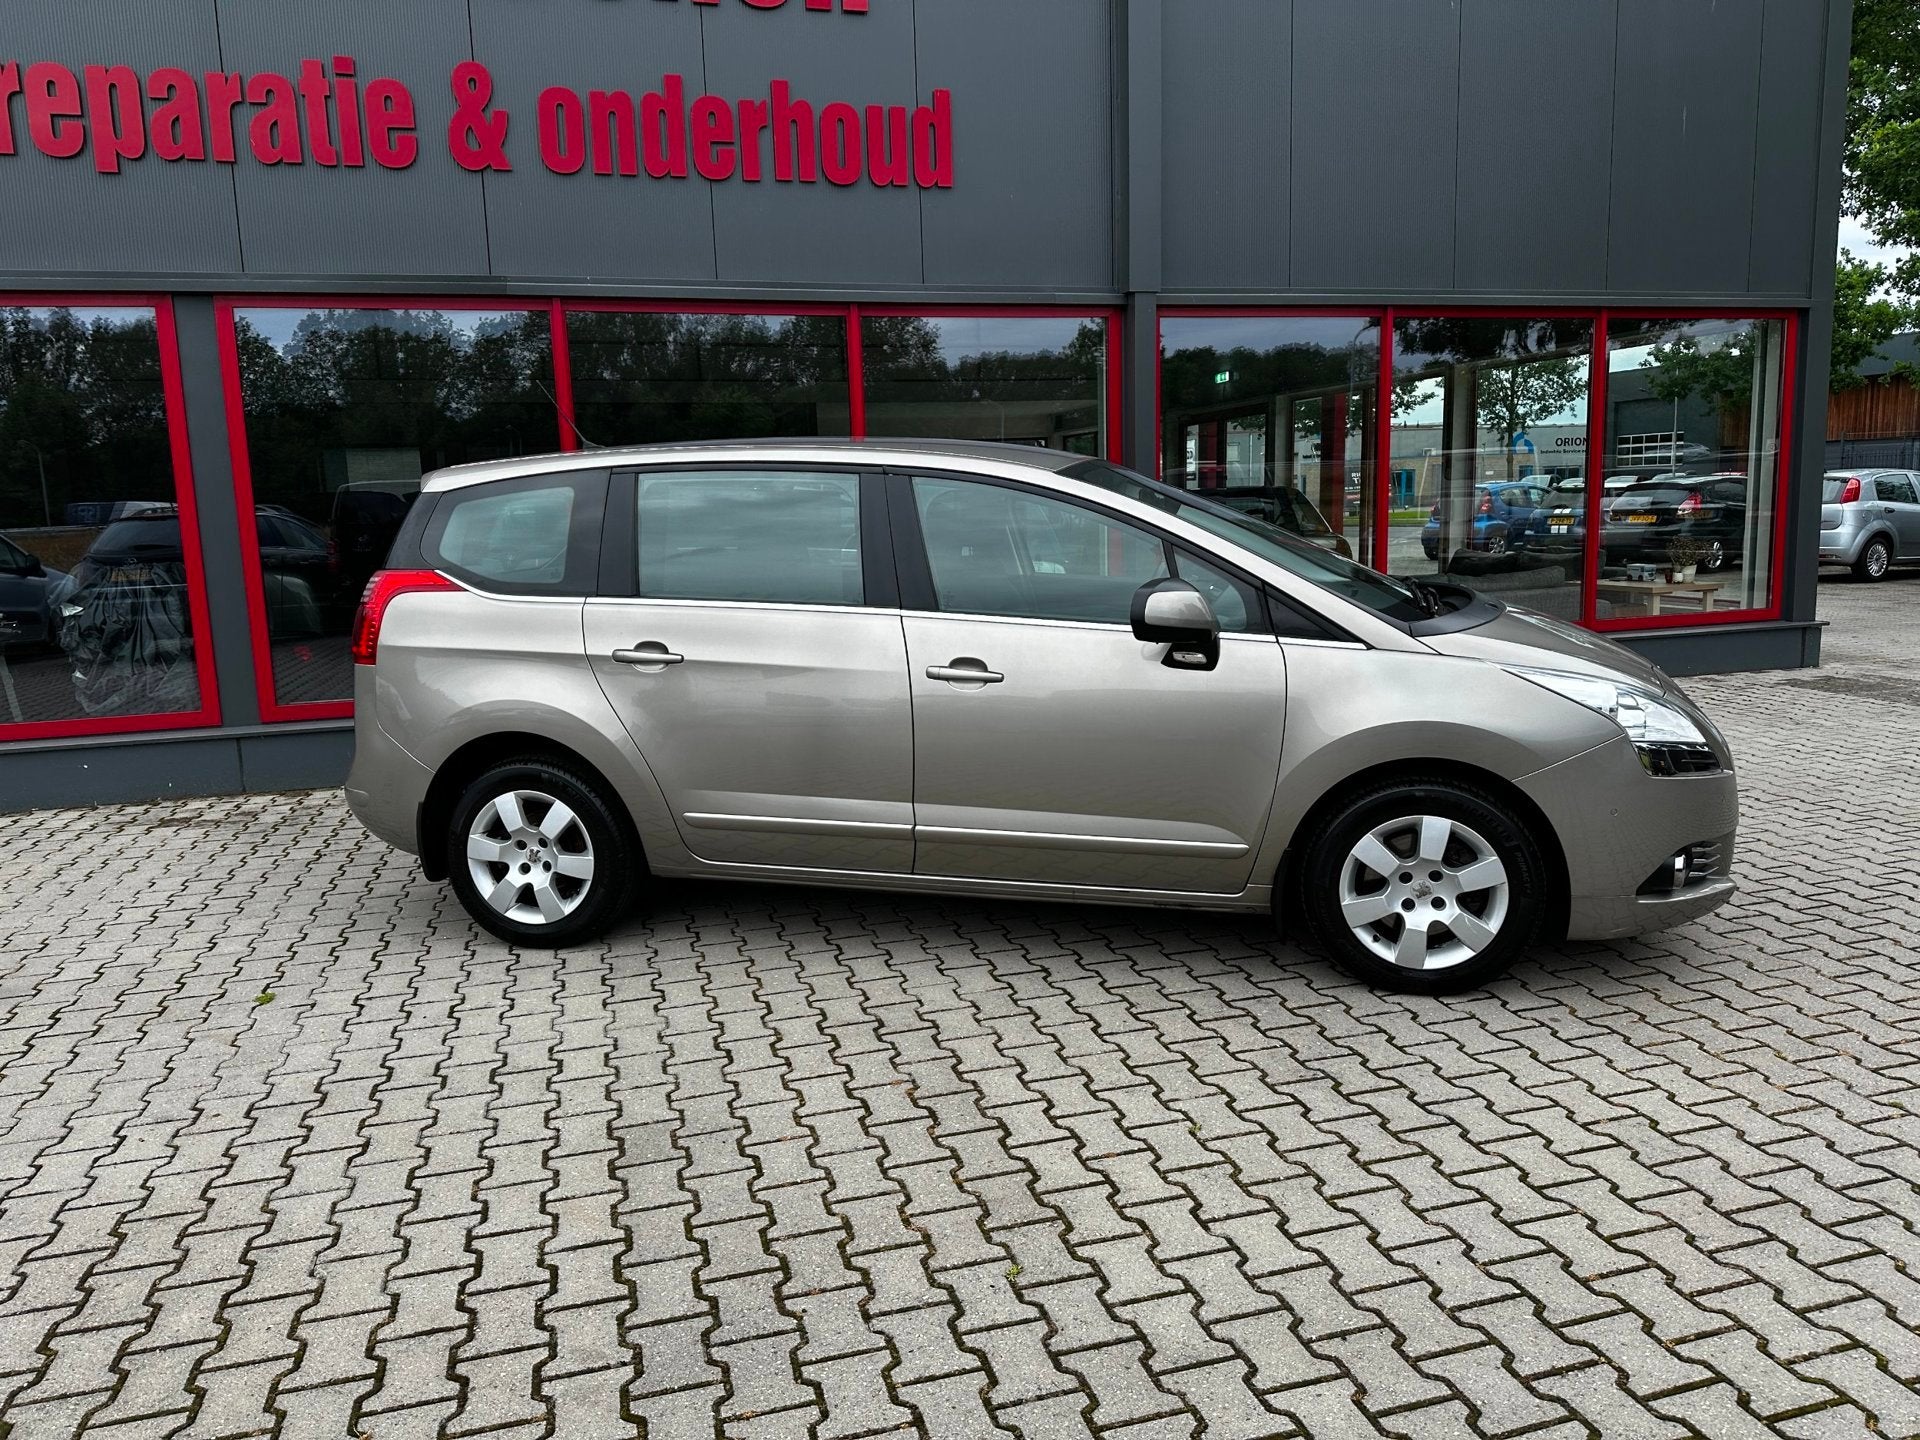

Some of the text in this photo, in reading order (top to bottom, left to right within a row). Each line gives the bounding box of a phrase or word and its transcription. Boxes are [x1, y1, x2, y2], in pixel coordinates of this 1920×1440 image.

[0, 56, 955, 188] reparatie & onderhoud
